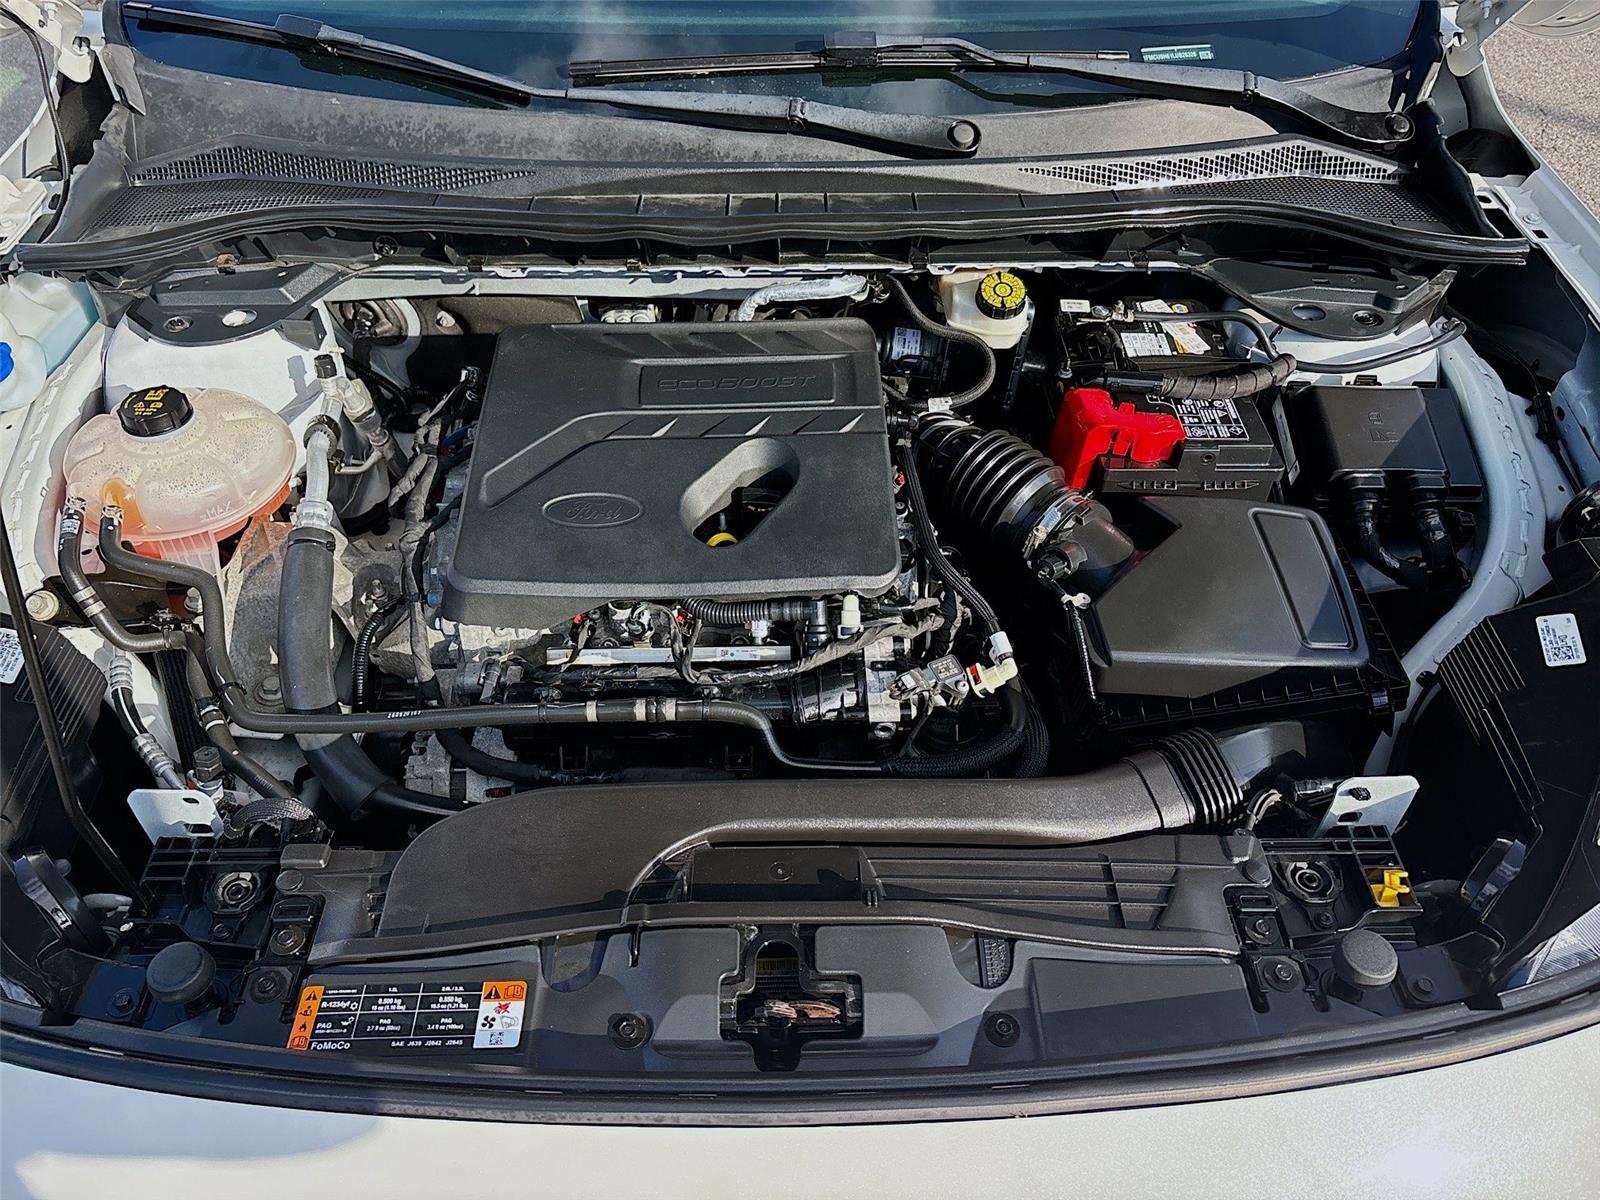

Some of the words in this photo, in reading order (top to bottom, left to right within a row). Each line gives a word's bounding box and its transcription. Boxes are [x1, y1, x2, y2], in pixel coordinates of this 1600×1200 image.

[658, 375, 816, 392] ECOBOOST
[566, 499, 625, 520] Ford
[321, 1000, 351, 1009] R-1234yf
[394, 998, 402, 1006] kg
[455, 996, 463, 1004] kg
[310, 1040, 351, 1051] FoMoCo
